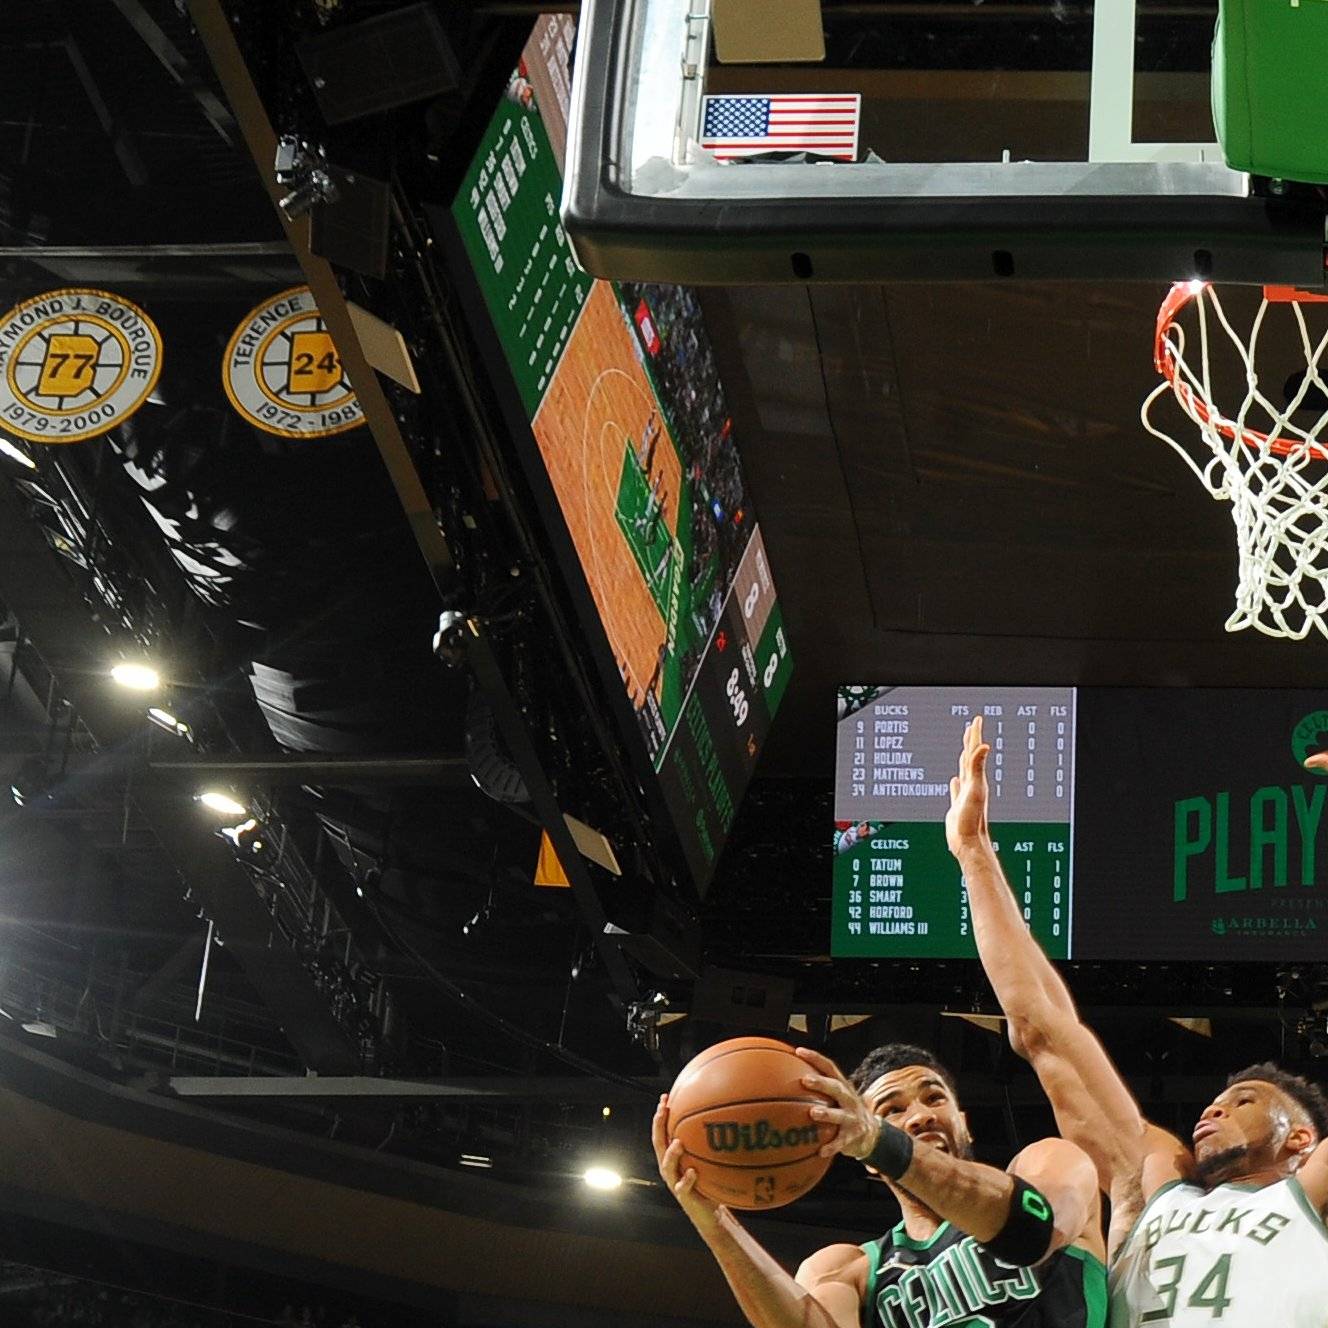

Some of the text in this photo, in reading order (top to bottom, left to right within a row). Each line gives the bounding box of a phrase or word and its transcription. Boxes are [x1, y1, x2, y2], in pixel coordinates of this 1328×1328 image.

[233, 296, 303, 368] TERENCE
[0, 299, 64, 371] AYMOND
[95, 301, 148, 380] BOURQUE
[49, 353, 95, 379] 77
[293, 353, 337, 375] 24
[4, 402, 116, 433] 1979-2000
[874, 706, 1067, 716] BUCKS PTS REB AST FLS
[857, 721, 864, 734] 9
[874, 721, 909, 734] PORTIS
[874, 737, 903, 749] LOPEZ
[874, 752, 912, 765] HOLIDAY
[853, 768, 864, 781] 23
[873, 768, 924, 781] MATTHEWS
[872, 783, 949, 797] ANTETOKOUNMP
[871, 839, 1064, 852] CELTICS AST FLS
[853, 859, 859, 871] 0
[871, 859, 902, 871] TATUM
[870, 875, 904, 887] BROWN
[849, 891, 862, 903] 36
[869, 891, 902, 903] SMART
[869, 906, 913, 919] HORFORD
[869, 922, 915, 935] WILLIAMS
[703, 1119, 821, 1153] Wilson
[1143, 1210, 1292, 1251] BUCKS
[1140, 1252, 1234, 1323] 34
